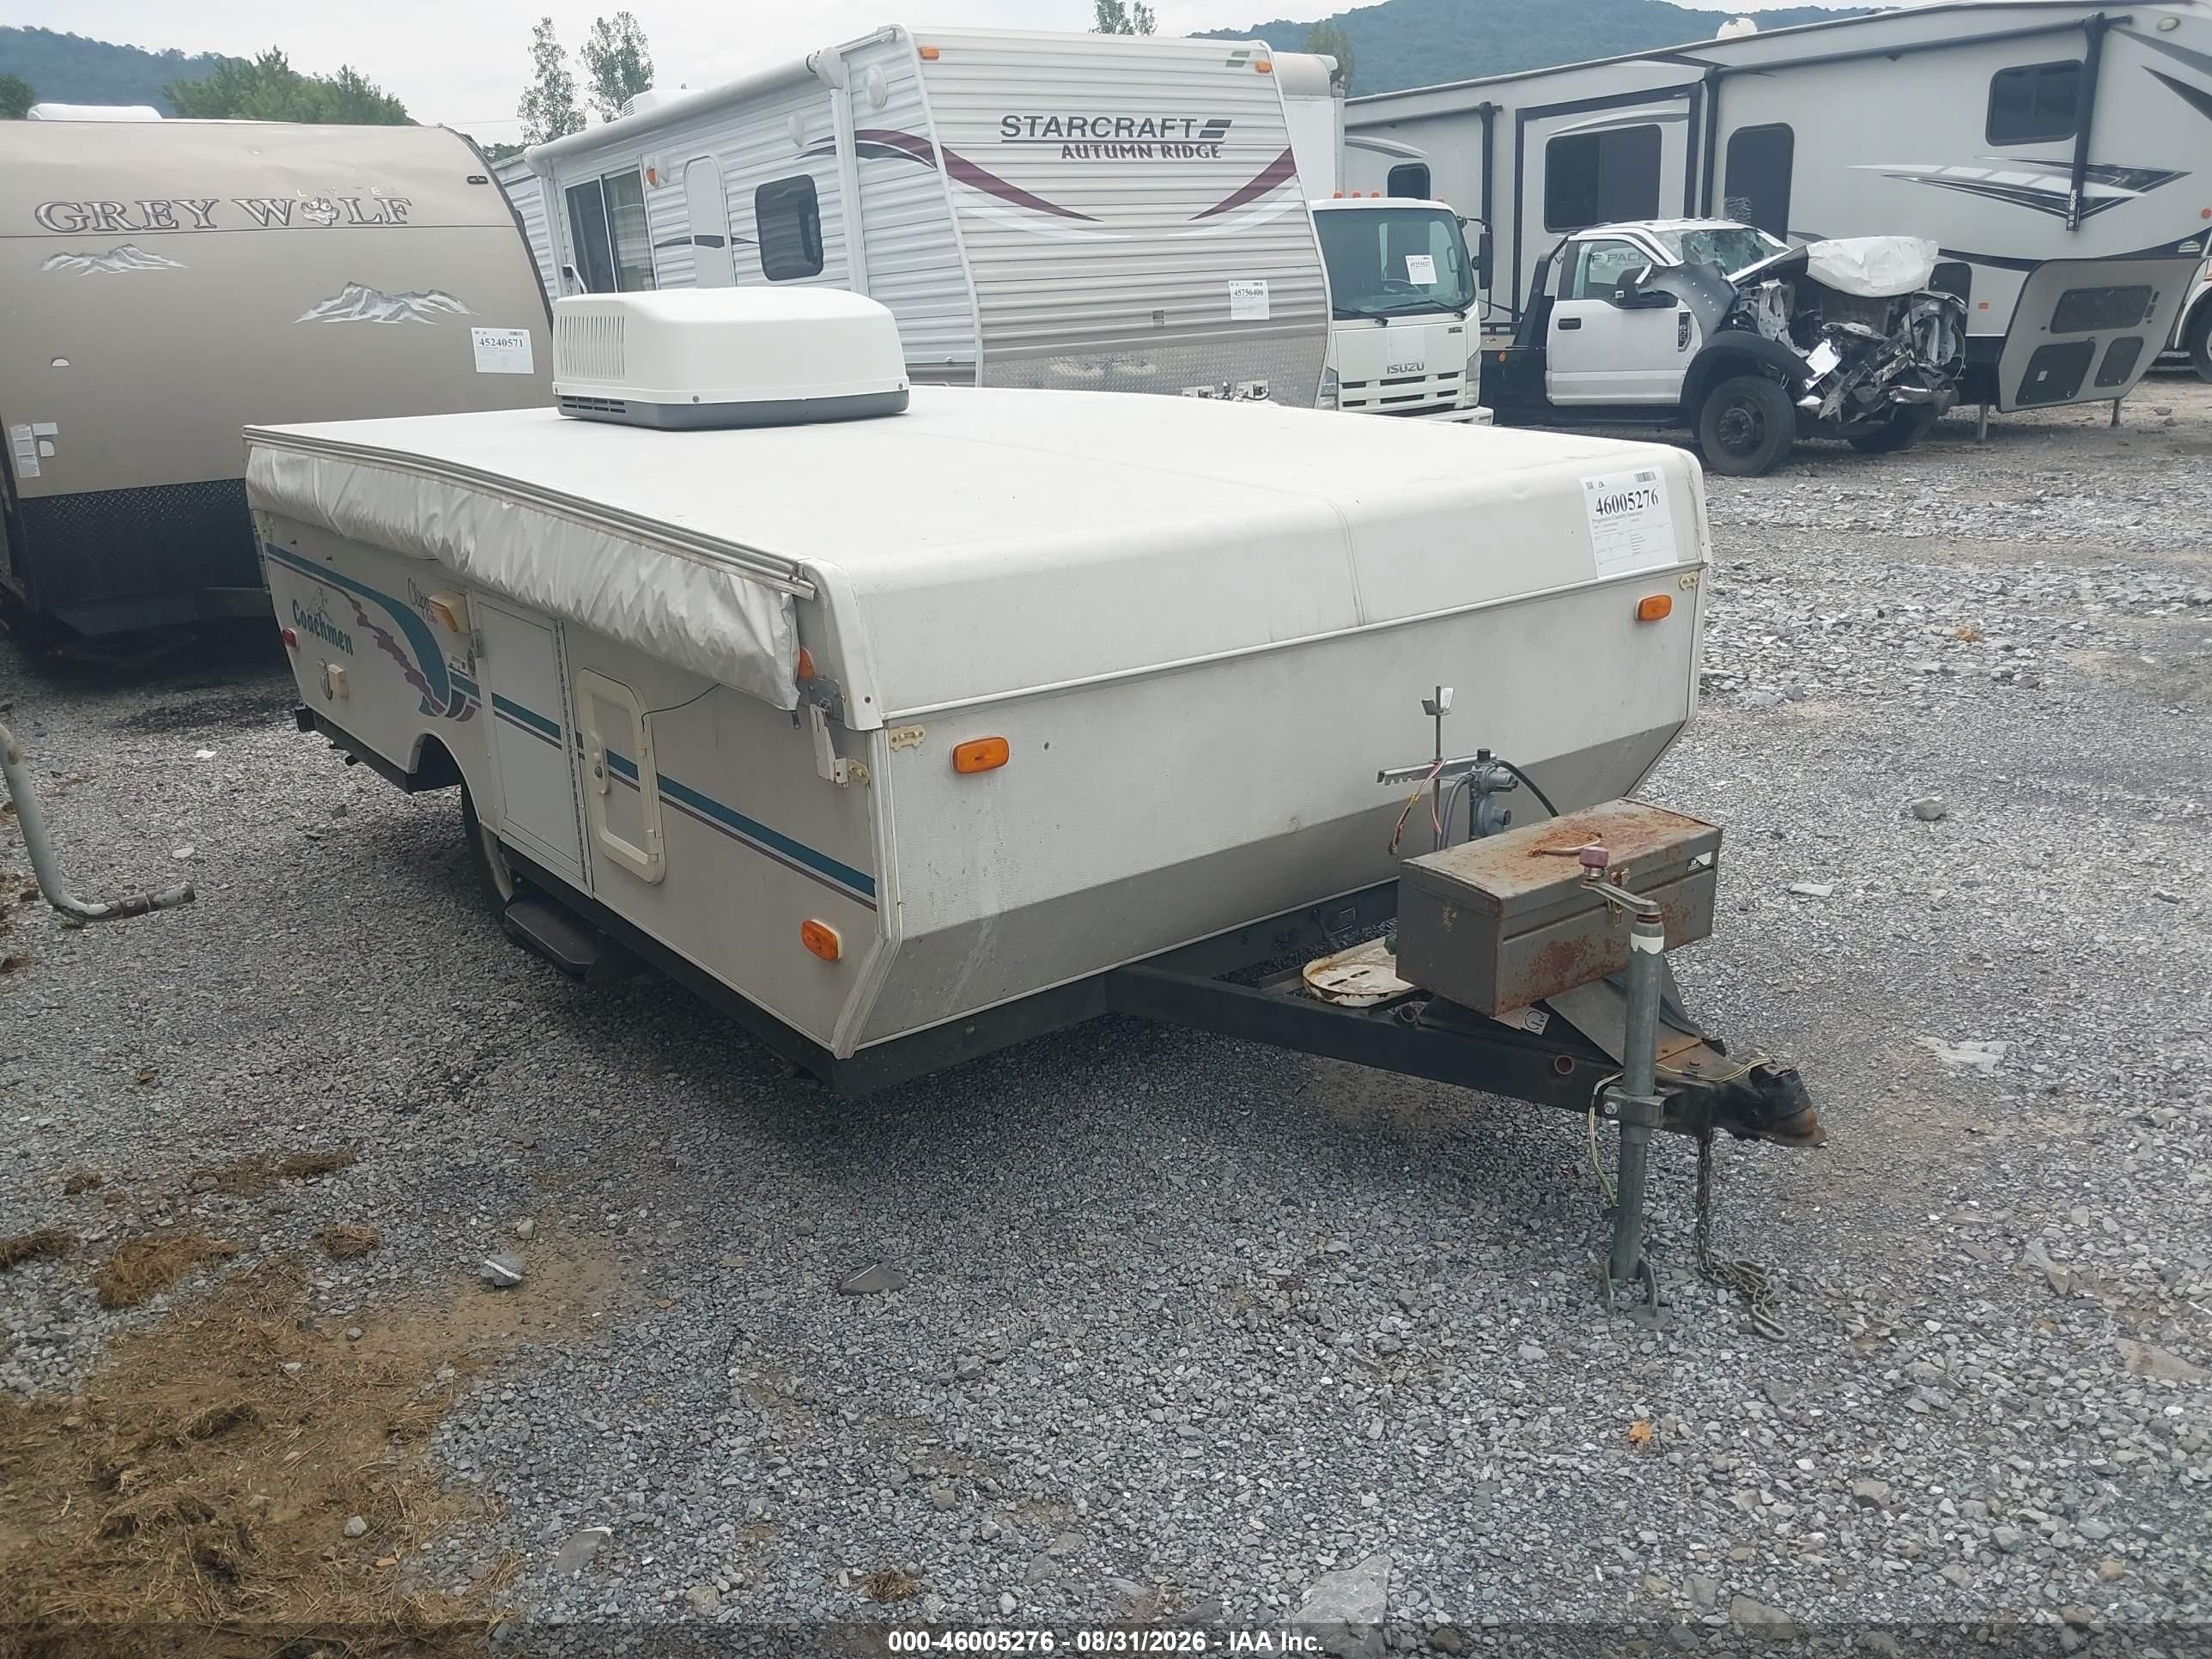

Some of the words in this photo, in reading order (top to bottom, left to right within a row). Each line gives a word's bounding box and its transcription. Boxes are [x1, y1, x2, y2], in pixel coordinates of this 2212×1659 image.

[1000, 114, 1198, 138] STARCRAFT
[1060, 144, 1154, 160] AUTUMN
[1162, 144, 1222, 160] RIDGE
[34, 199, 220, 234] GREY
[479, 337, 524, 348] 45240571
[1386, 361, 1425, 374] ISUZU
[1595, 487, 1660, 516] 46005276
[292, 599, 355, 657] Coachmen
